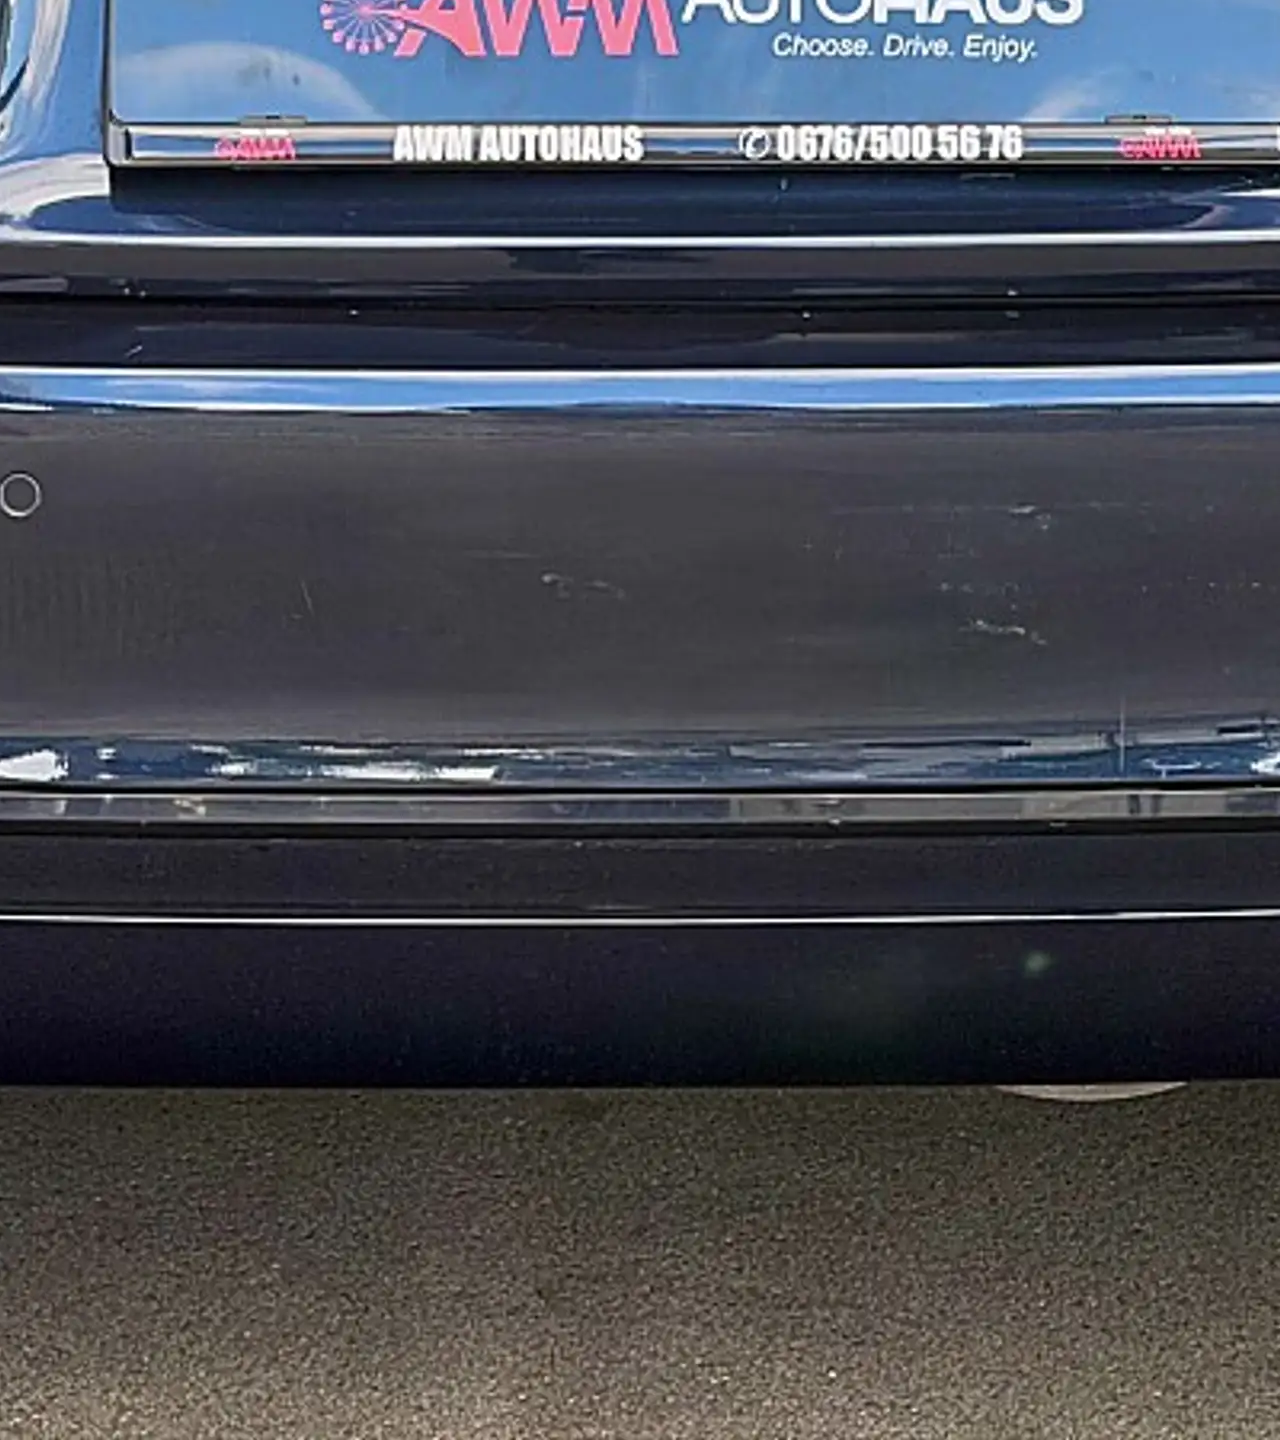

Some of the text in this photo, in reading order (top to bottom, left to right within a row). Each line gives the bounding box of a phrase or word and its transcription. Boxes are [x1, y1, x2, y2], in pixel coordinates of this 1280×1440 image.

[773, 32, 1039, 63] Choose. Drive. Enjoy.
[392, 124, 646, 161] AWM AUTOHAUS
[777, 123, 932, 160] 0676/500
